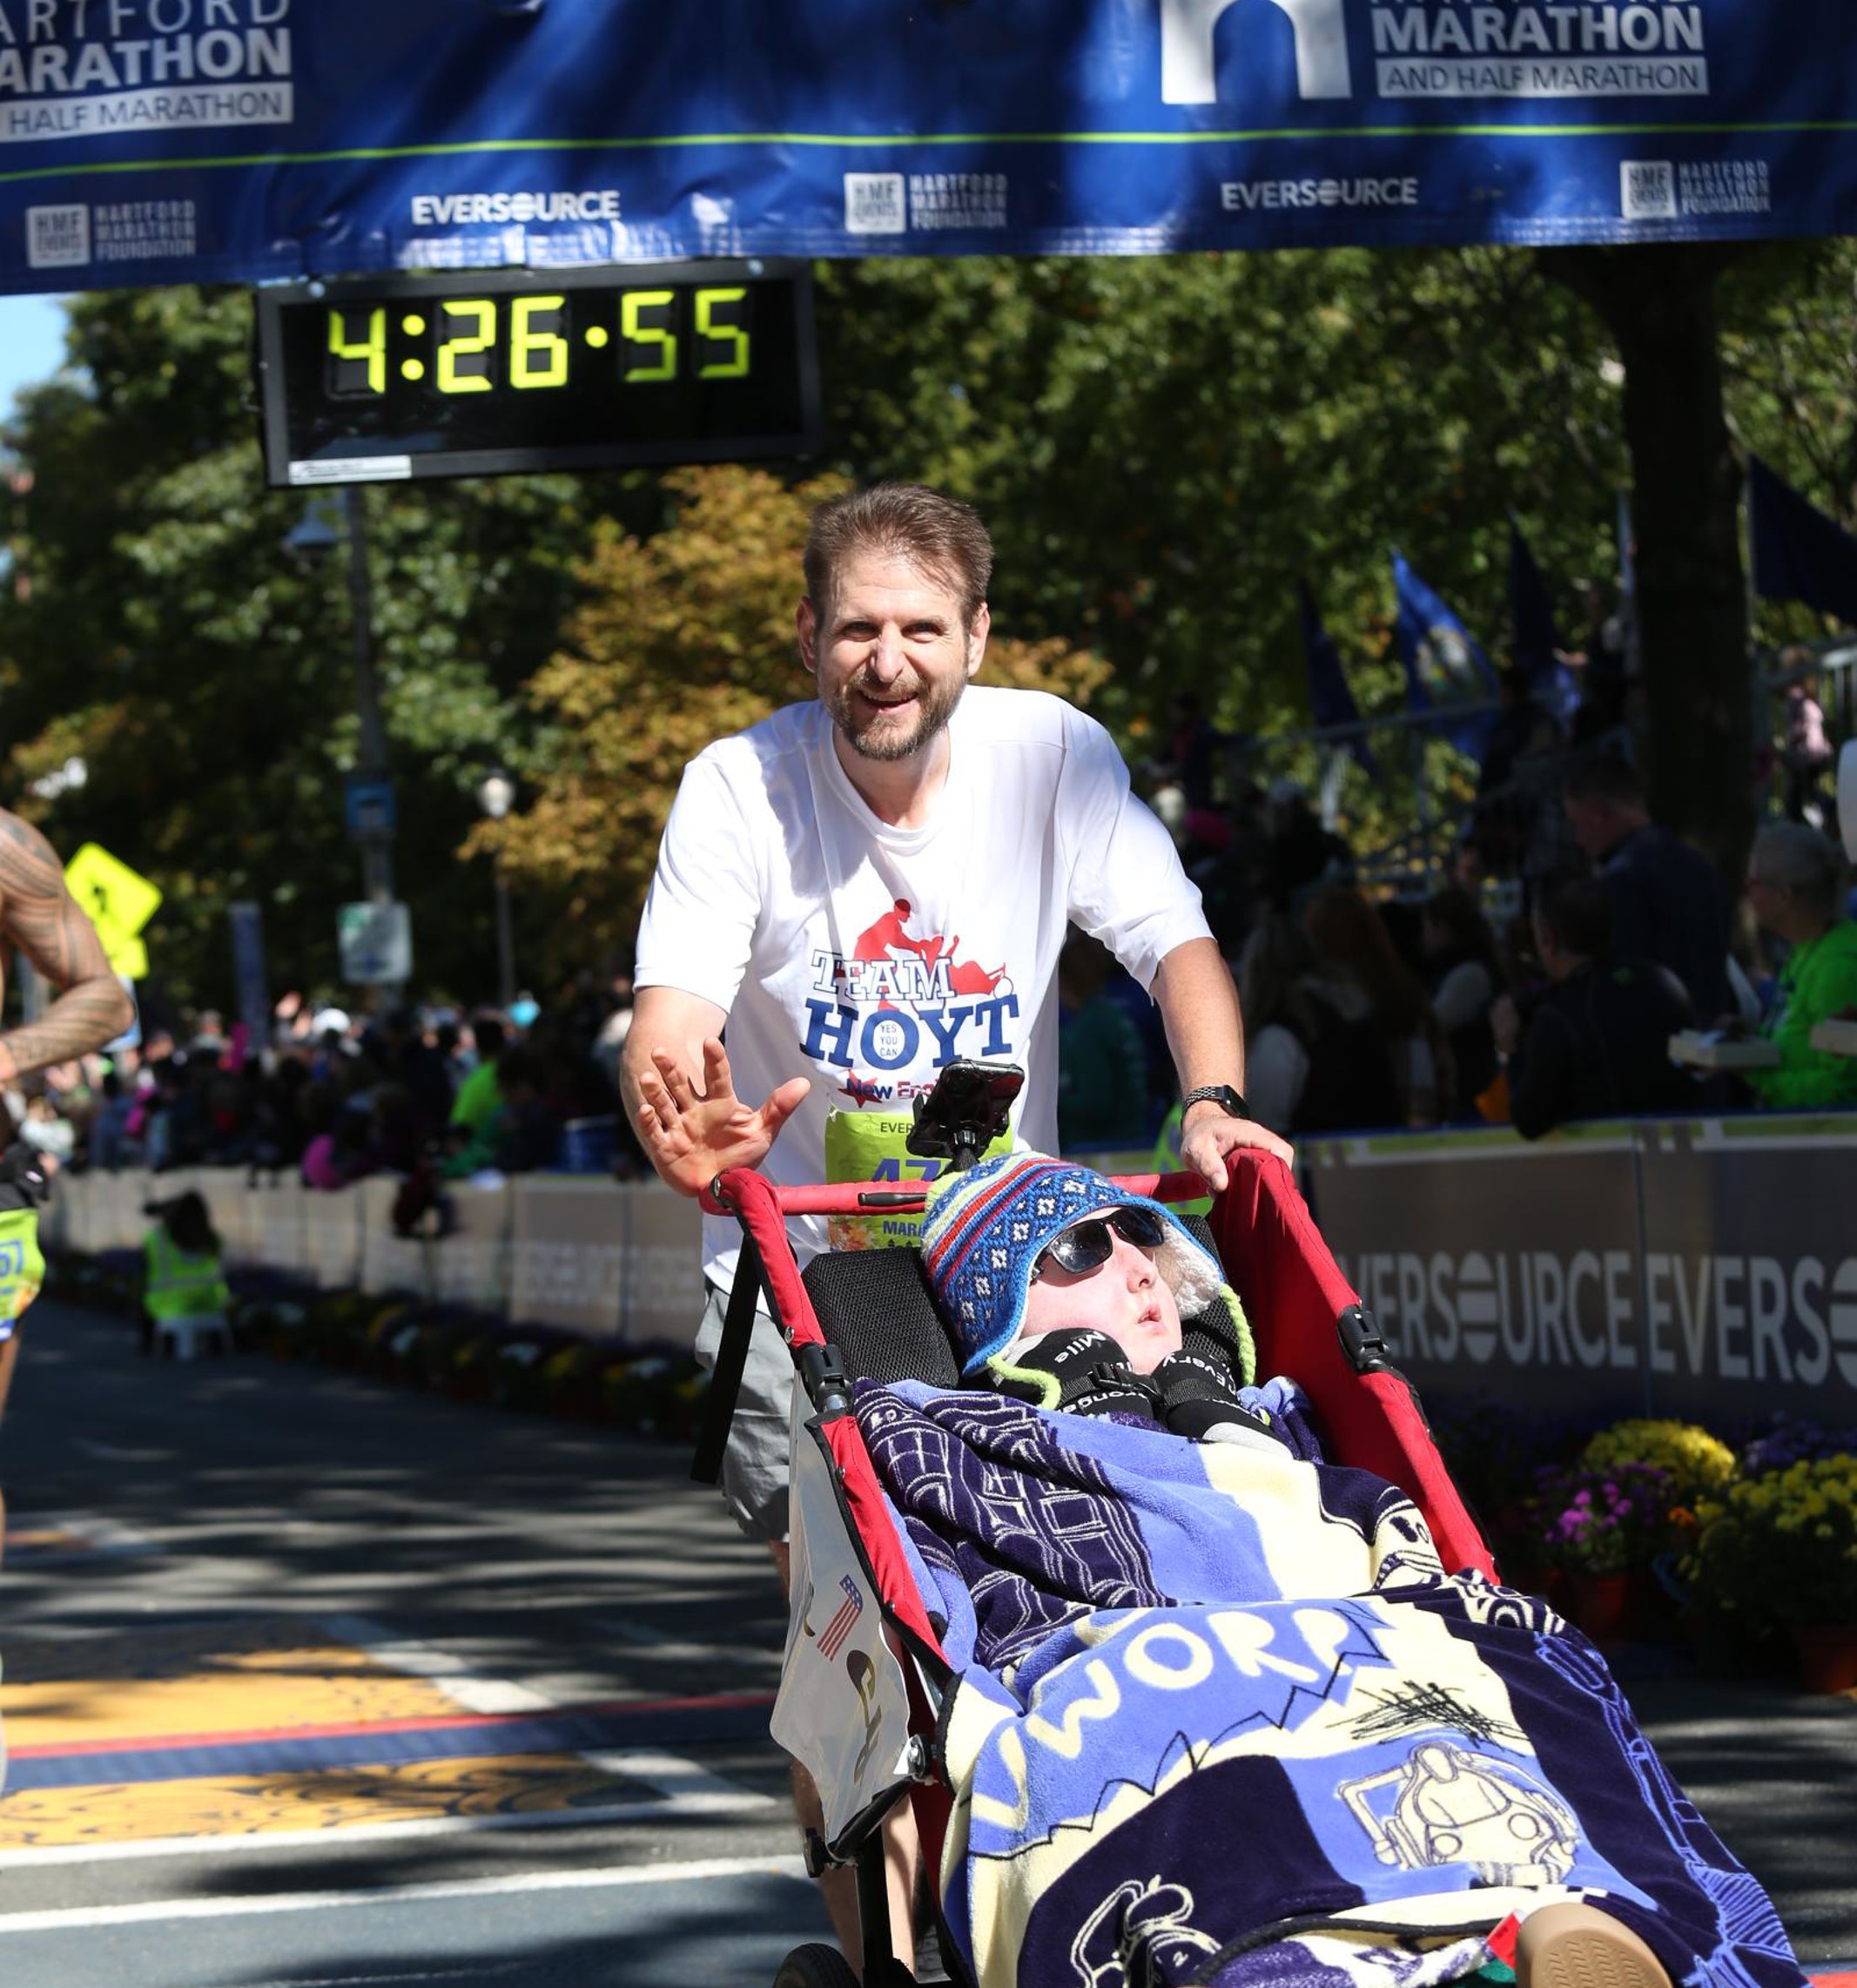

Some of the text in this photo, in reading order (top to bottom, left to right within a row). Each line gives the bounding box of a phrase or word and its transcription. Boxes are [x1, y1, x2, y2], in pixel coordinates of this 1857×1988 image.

[1372, 6, 1704, 53] MARATHON
[1386, 65, 1699, 91] AND HALF MARATHON
[11, 91, 282, 134] HALF MARATHON
[94, 199, 195, 222] HARTFORD
[412, 190, 621, 227] EVERSOURCE
[1221, 178, 1418, 211] EVERSOURCE
[811, 949, 957, 1001] TEAM
[799, 994, 1019, 1070] HOYT
[880, 1023, 897, 1034] YES
[880, 1035, 898, 1046] YOU
[879, 1047, 898, 1057] CAN
[847, 1078, 893, 1100] New
[1053, 1330, 1107, 1365] Mile
